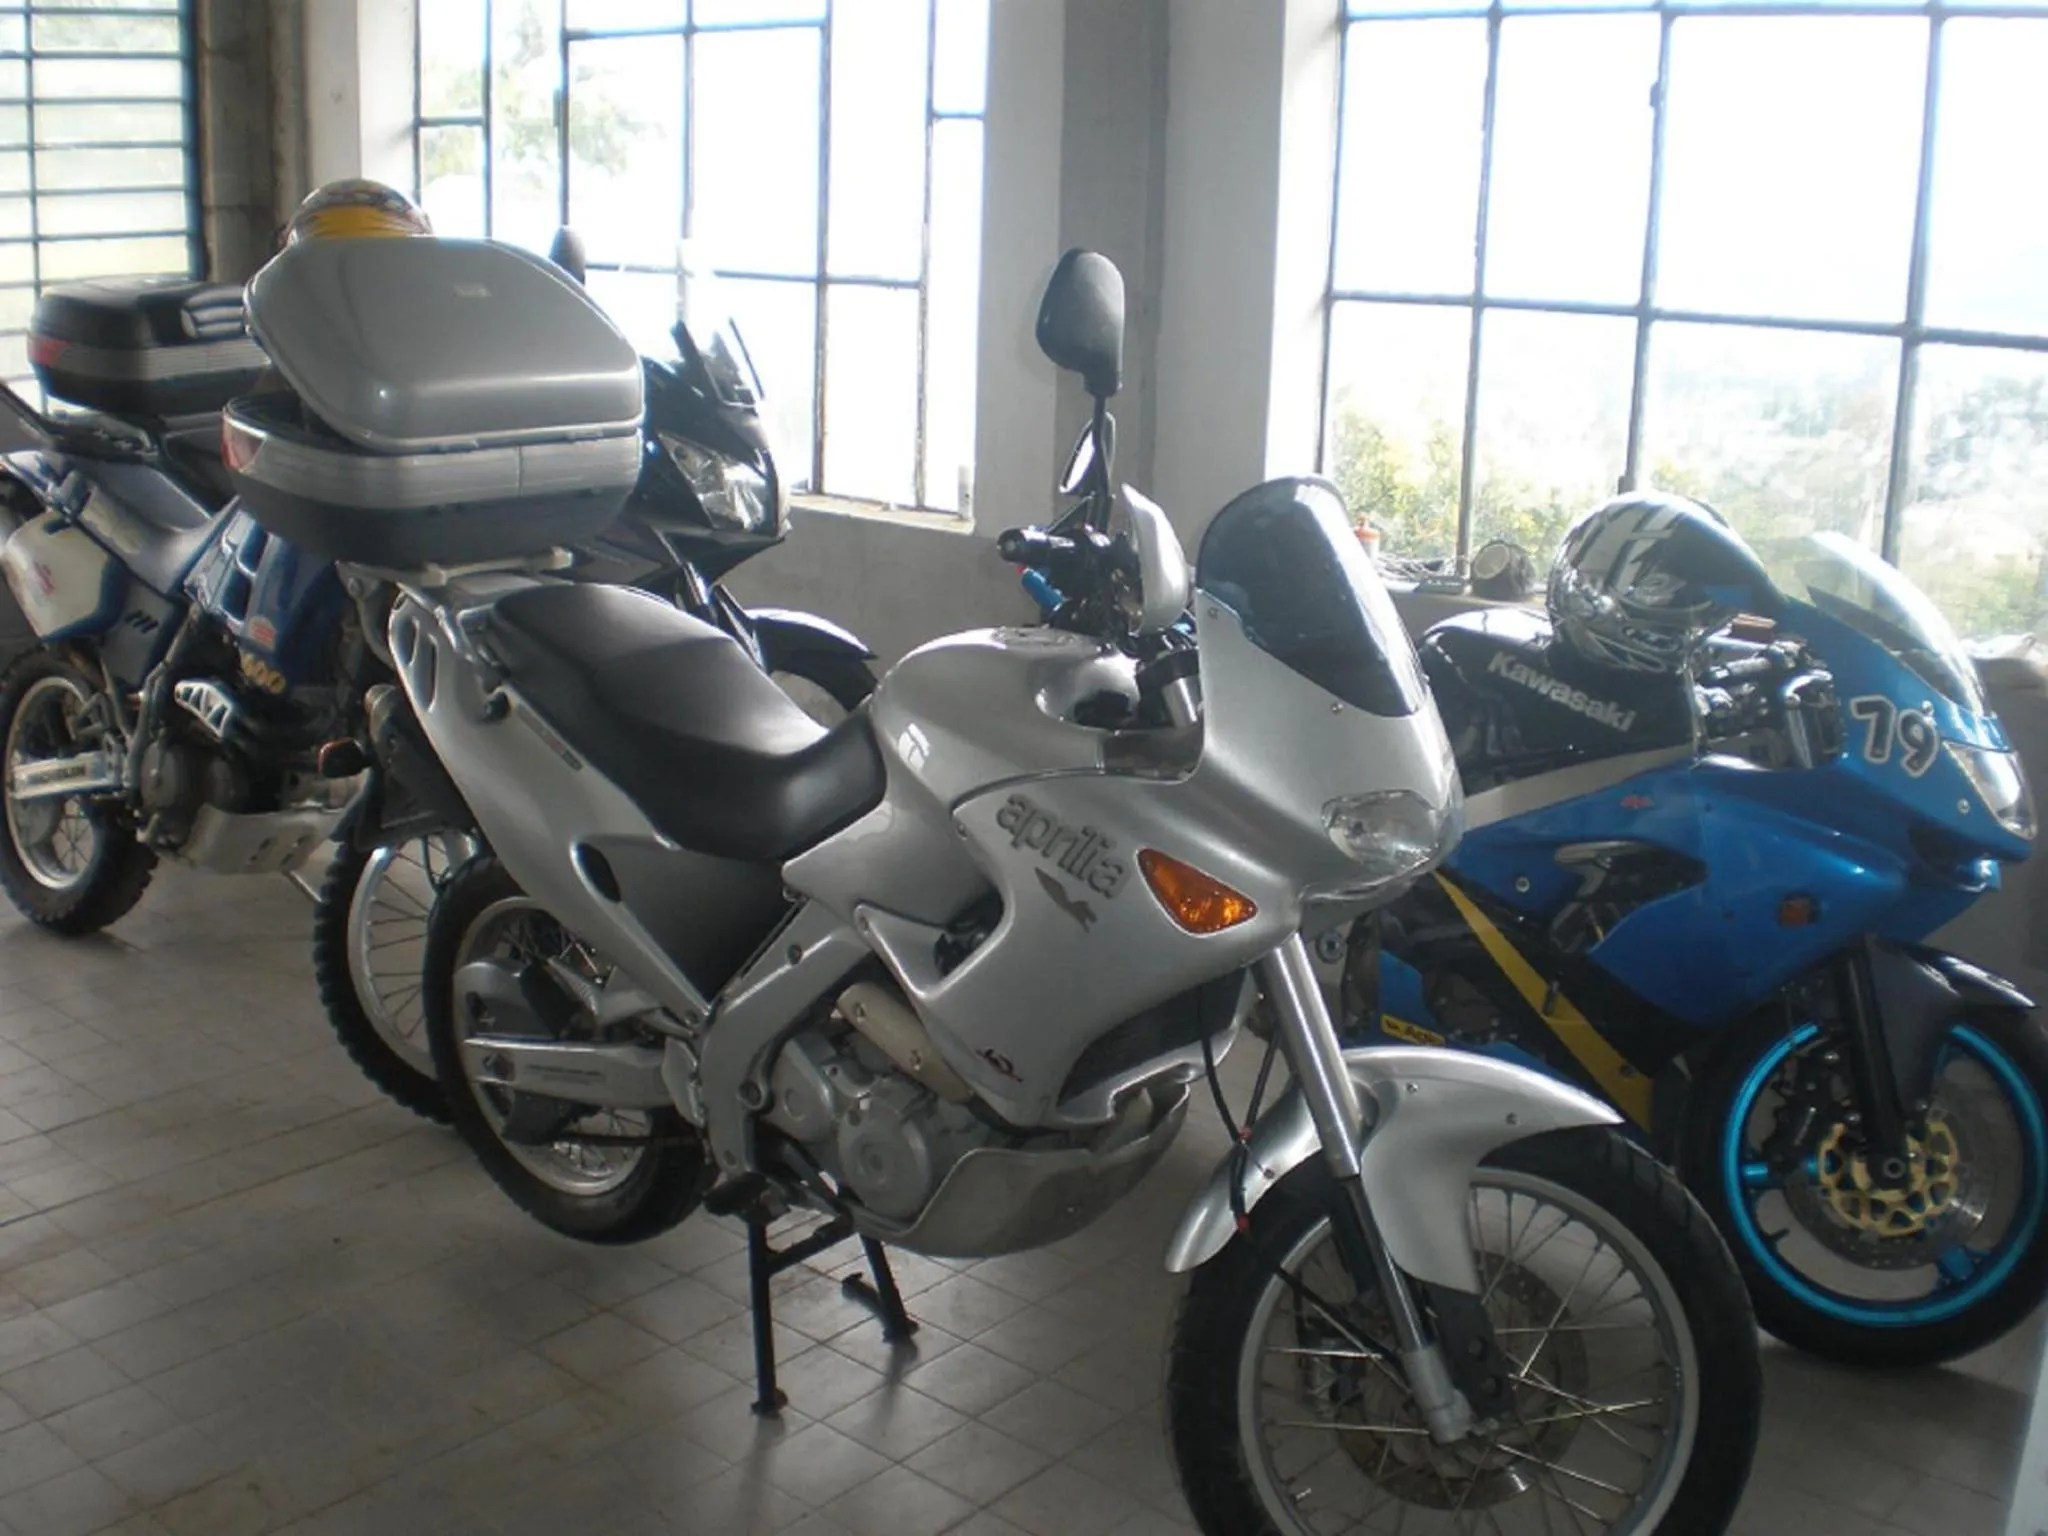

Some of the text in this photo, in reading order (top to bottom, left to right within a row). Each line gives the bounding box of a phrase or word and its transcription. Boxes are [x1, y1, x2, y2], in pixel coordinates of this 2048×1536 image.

[1487, 651, 1637, 732] Kawasaki
[1850, 694, 1938, 778] 79
[996, 793, 1131, 900] aprilia
